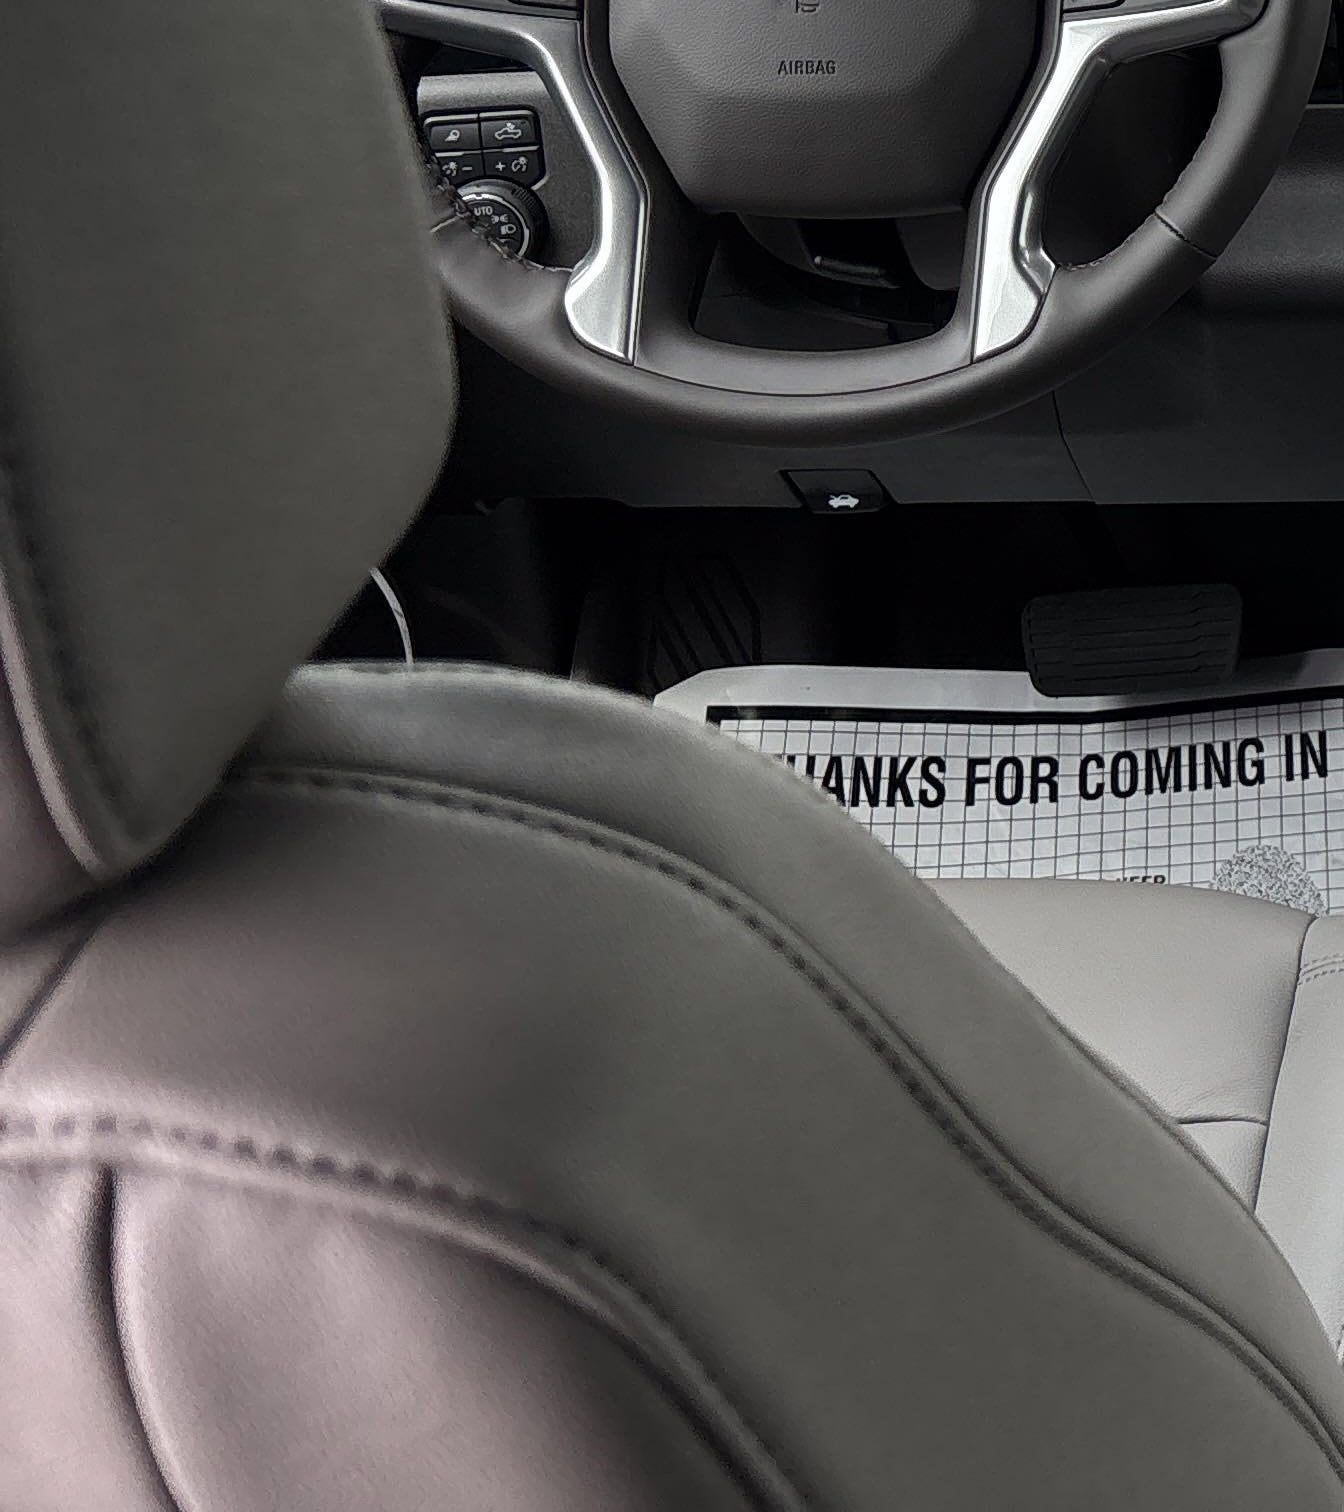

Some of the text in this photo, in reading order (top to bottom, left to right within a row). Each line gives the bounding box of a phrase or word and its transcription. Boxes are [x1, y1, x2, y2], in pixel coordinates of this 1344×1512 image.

[777, 59, 837, 75] AIRBAG
[473, 206, 494, 216] UTO
[775, 729, 1330, 809] ANKS FOR COMING IN
